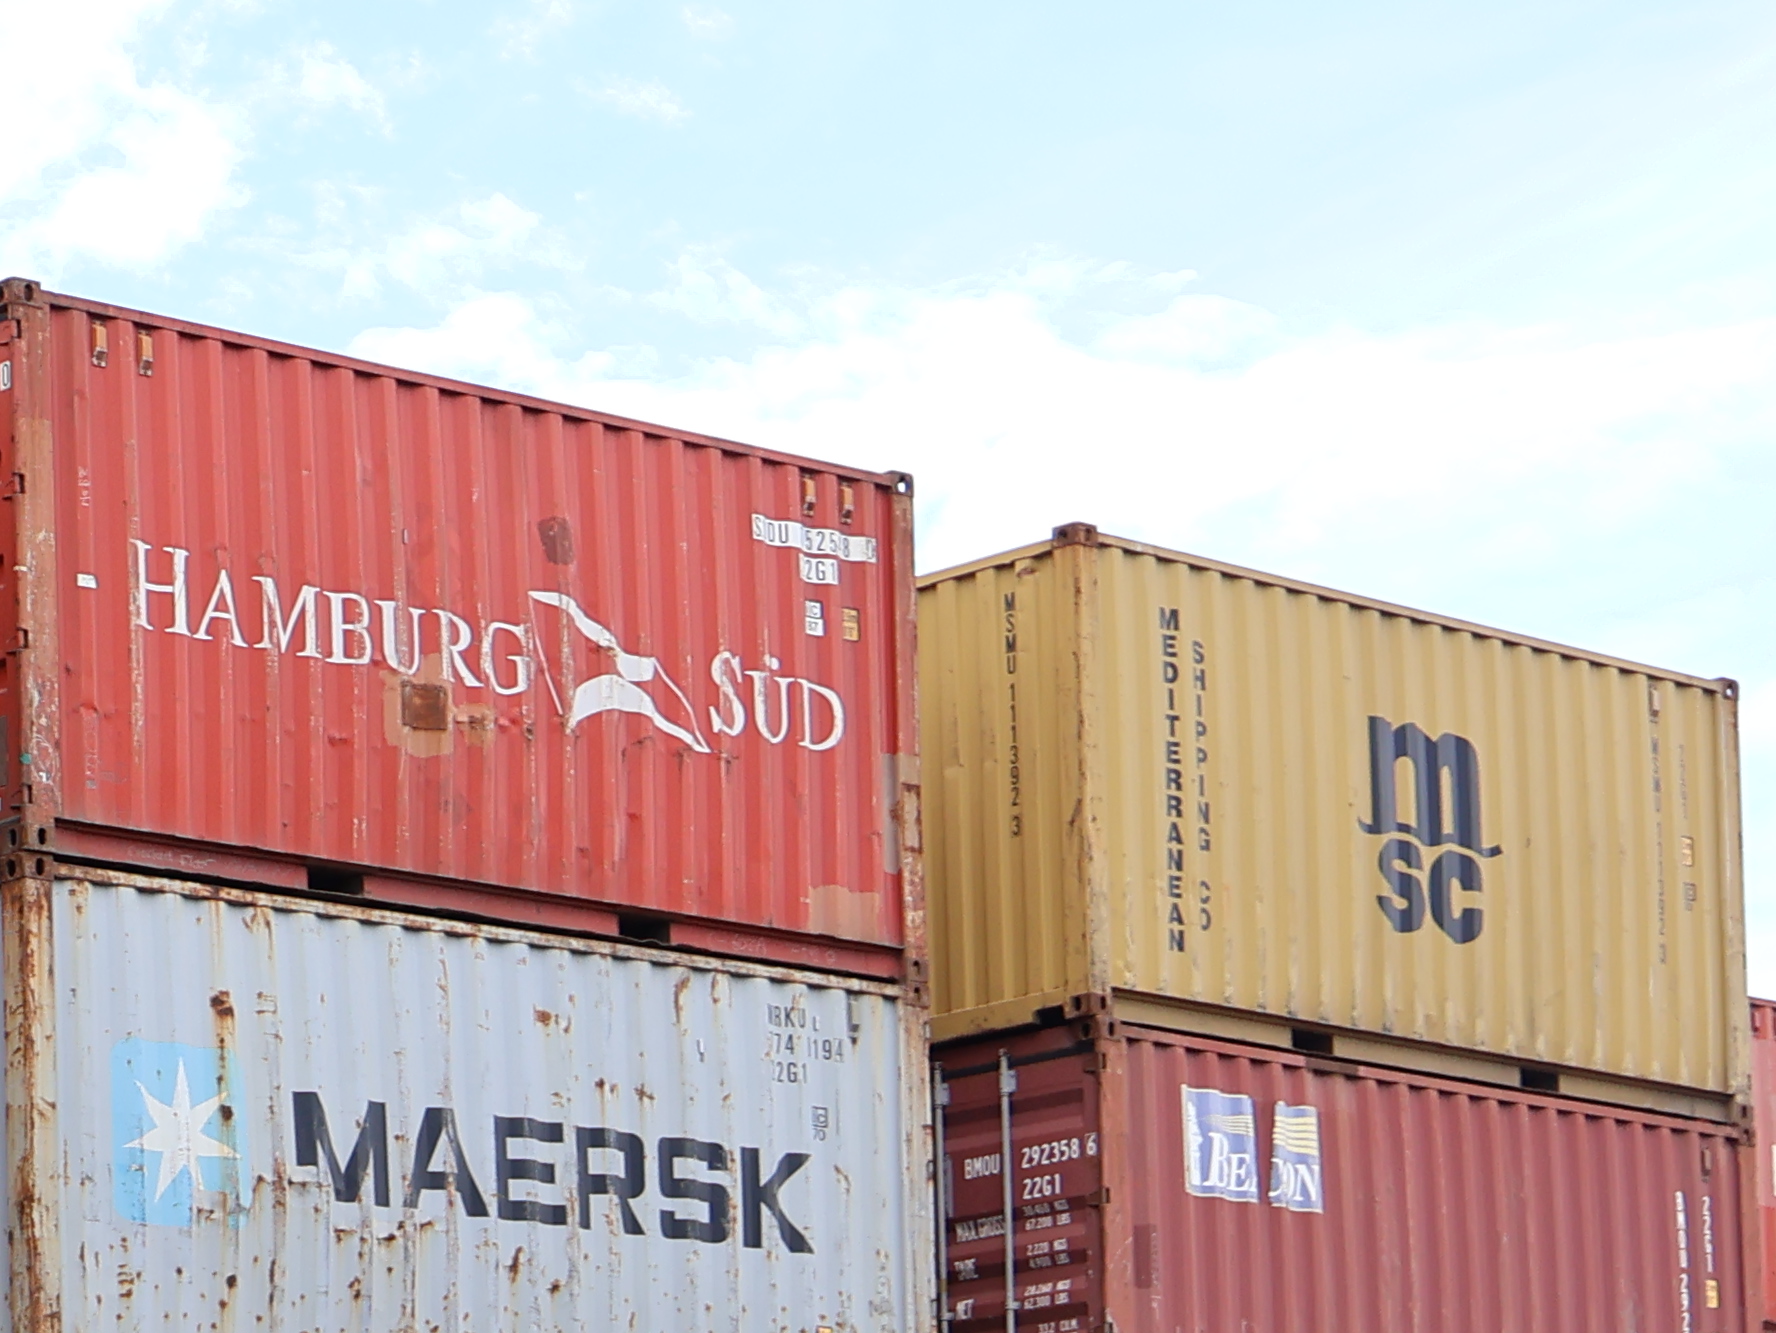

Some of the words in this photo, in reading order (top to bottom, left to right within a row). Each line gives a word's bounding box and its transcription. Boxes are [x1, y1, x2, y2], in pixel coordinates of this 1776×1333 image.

[131, 539, 534, 697] HAMBURG
[709, 651, 845, 753] SÜD
[1158, 605, 1186, 953] MEDITERRANEAN
[1192, 640, 1211, 852] SHIPPING
[291, 1089, 815, 1255] MAERSK
[963, 1153, 1001, 1181] BMOU
[1020, 1137, 1081, 1169] 292358
[1021, 1173, 1062, 1200] 22G1
